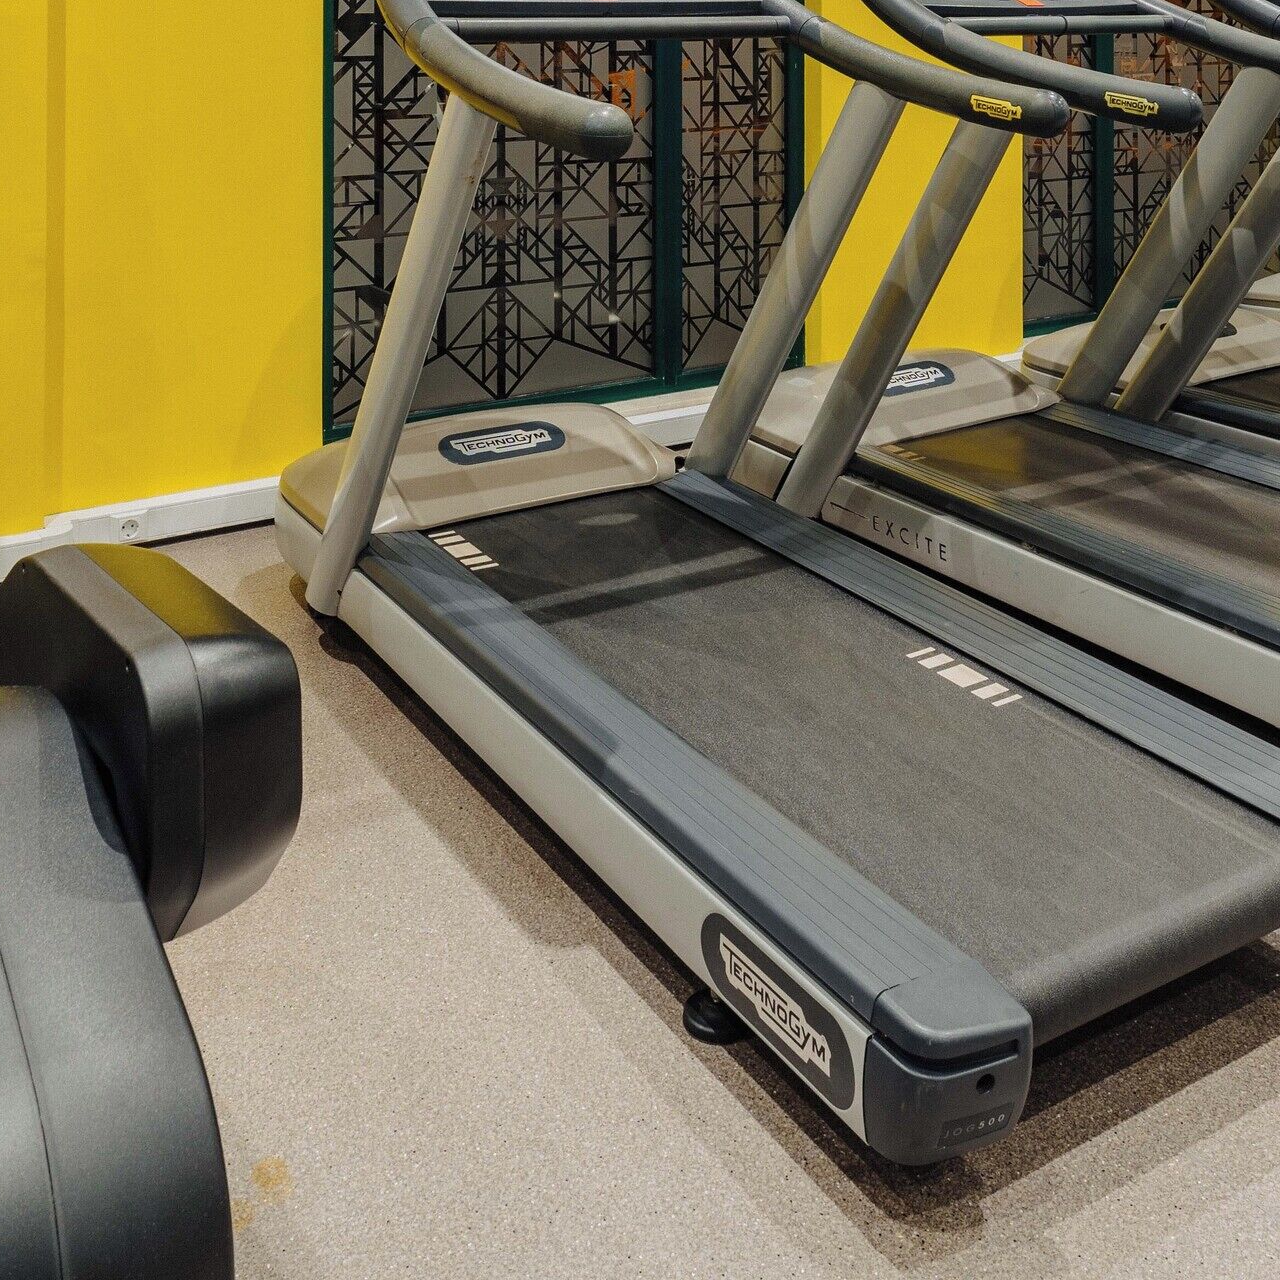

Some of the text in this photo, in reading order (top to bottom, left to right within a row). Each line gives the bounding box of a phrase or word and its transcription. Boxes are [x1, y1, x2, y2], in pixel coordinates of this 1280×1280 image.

[455, 432, 546, 452] TECHNOGYM
[872, 515, 947, 561] EXCITE
[723, 942, 825, 1062] TECHNOGYM
